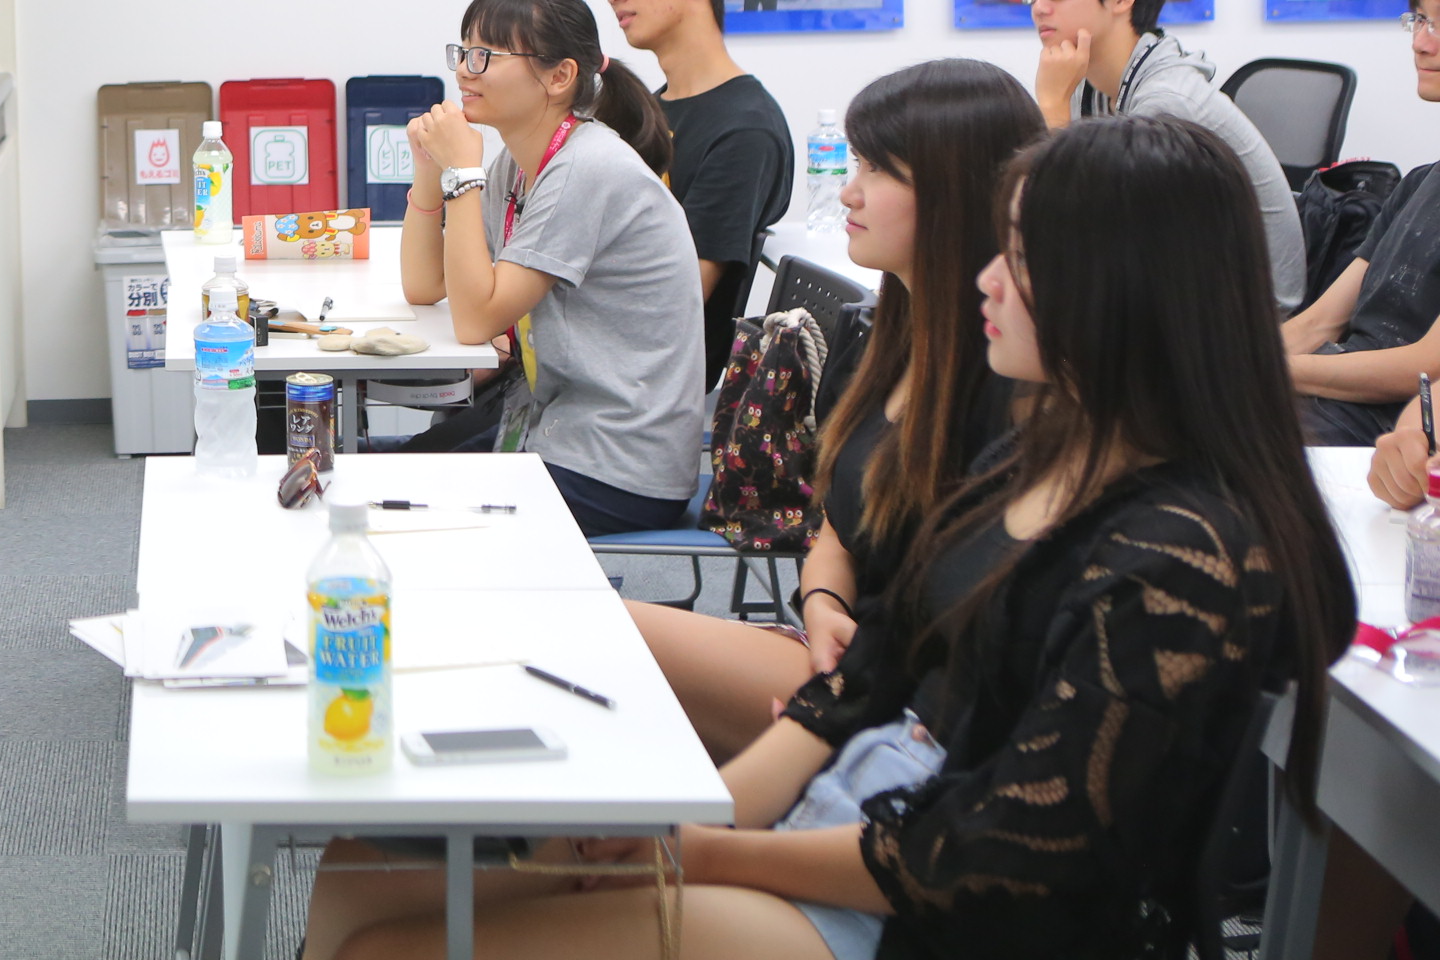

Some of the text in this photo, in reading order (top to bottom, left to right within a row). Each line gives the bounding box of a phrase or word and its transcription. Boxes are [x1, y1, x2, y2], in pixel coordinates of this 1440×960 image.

[268, 160, 292, 172] PET
[127, 283, 158, 292] カラーで
[127, 291, 158, 308] 分別
[322, 634, 378, 653] FRUIT
[320, 651, 381, 669] WATER
